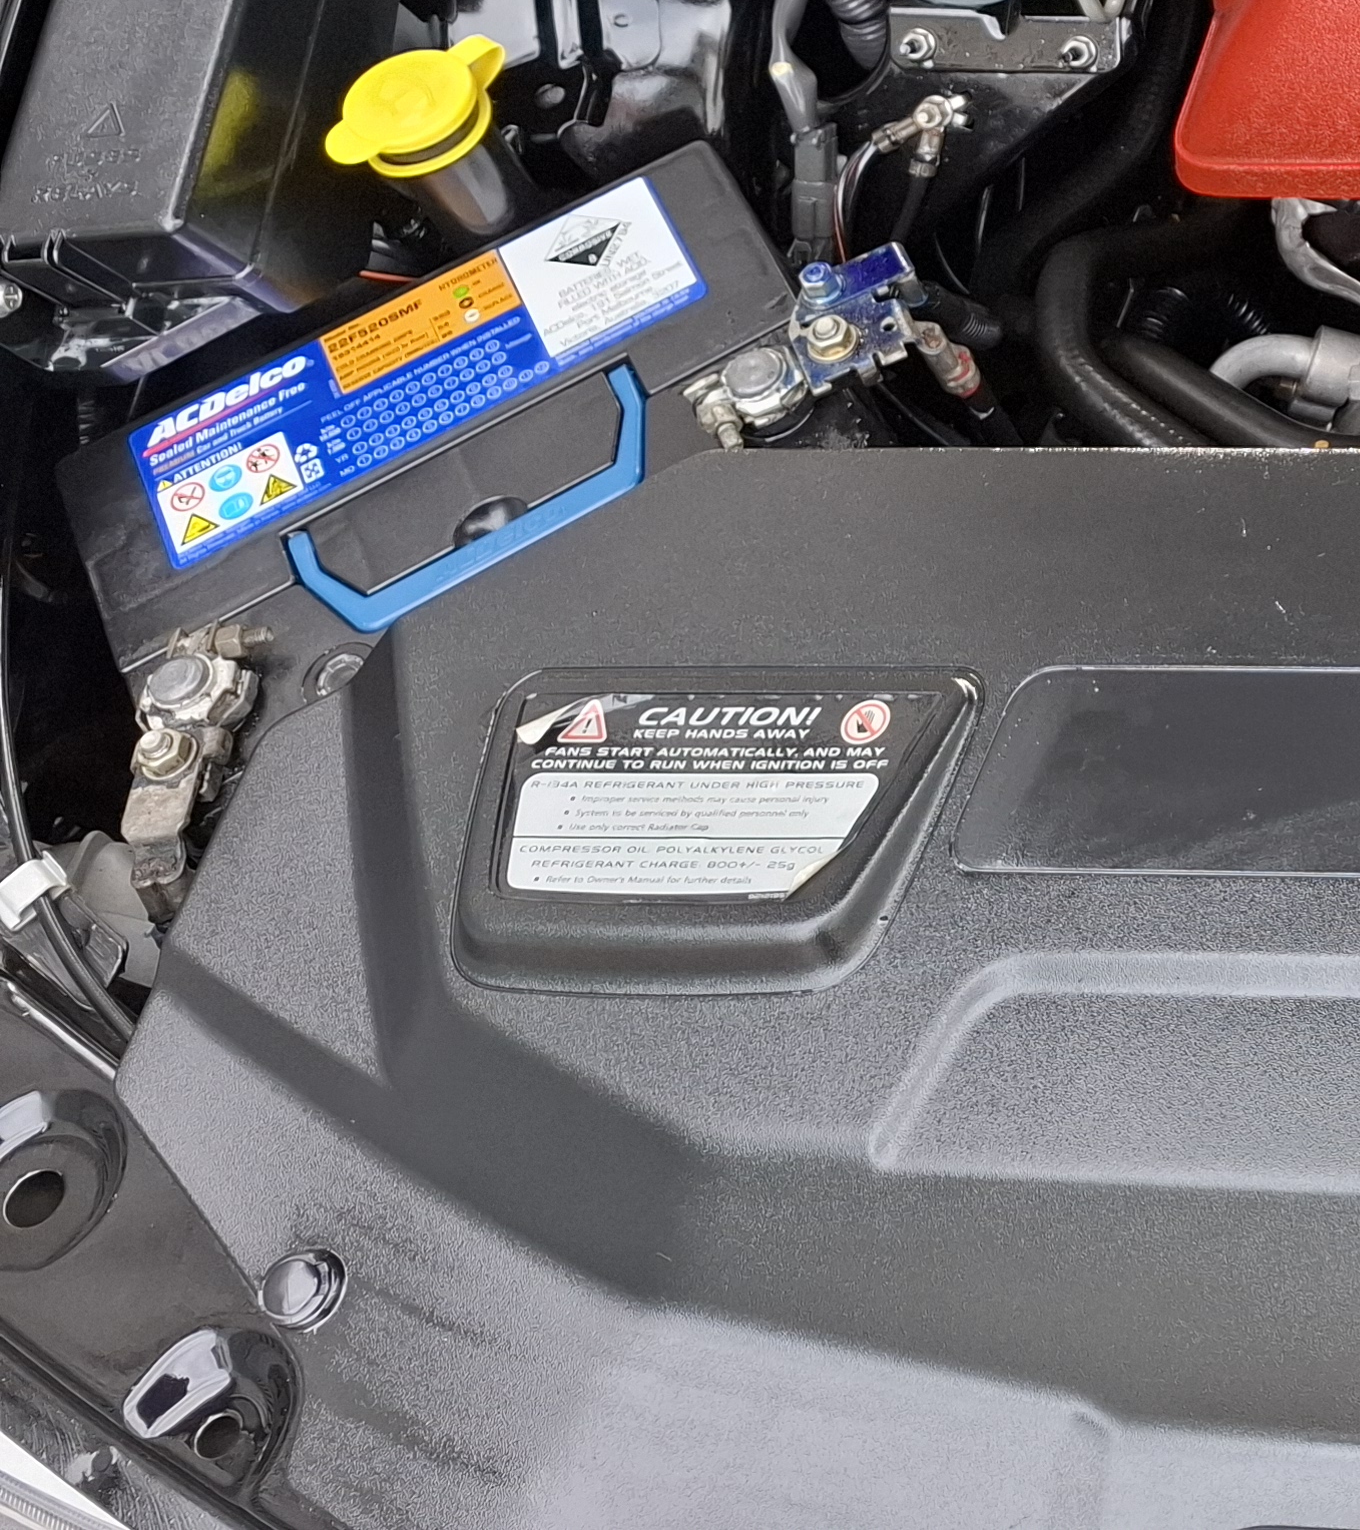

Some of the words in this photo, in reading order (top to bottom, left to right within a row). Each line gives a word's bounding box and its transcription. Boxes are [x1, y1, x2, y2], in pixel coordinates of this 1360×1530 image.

[557, 228, 613, 262] CORROSIVE
[599, 221, 632, 267] UN2794
[437, 256, 498, 292] HYDROMETER
[556, 285, 592, 309] FILLED
[592, 270, 622, 291] WITH
[600, 283, 654, 317] Melbourne
[325, 297, 424, 354] 22F520SMF
[318, 406, 344, 424] PEEL
[342, 397, 362, 412] OFF
[361, 370, 414, 402] APPLICABLE
[412, 351, 451, 376] NUMBER
[448, 337, 477, 356] WHEN
[475, 314, 522, 342] INSTALLED
[147, 354, 310, 448] ACDelco
[146, 435, 196, 467] Sealed
[192, 393, 278, 444] Maintenance
[274, 378, 308, 403] Free
[194, 440, 212, 454] Car
[210, 432, 229, 446] and
[228, 420, 253, 437] Truck
[251, 404, 285, 426] Battery
[170, 440, 244, 483] ATTENTION!
[638, 706, 823, 726] CAUTION!
[632, 728, 679, 739] KEEP
[685, 728, 748, 739] HANDS
[752, 728, 810, 739] AWAY
[530, 759, 616, 769] CONTINUE
[622, 759, 646, 769] TO
[649, 759, 689, 769] RUN
[692, 759, 746, 769] WHEN
[750, 759, 826, 770] IGNITION
[830, 759, 847, 770] IS
[852, 759, 889, 770] OFF
[543, 746, 592, 758] FANS
[596, 746, 653, 758] START
[656, 746, 798, 758] AUTOMATICALLY,
[802, 746, 841, 758] AND
[845, 746, 886, 758] MAY
[584, 780, 684, 789] REFRIGERANT
[689, 780, 740, 789] UNDER
[745, 780, 779, 789] HIGH
[784, 780, 864, 789] PRESSURE
[581, 795, 625, 804] Improper
[628, 795, 660, 804] service
[662, 795, 704, 804] methods
[729, 795, 756, 804] cause
[759, 795, 800, 804] personal
[568, 822, 586, 831] Use
[589, 822, 609, 831] only
[611, 822, 645, 831] correct
[647, 822, 688, 831] Radiator
[691, 822, 709, 831] Cap
[574, 809, 608, 818] System
[625, 809, 637, 818] be
[639, 809, 678, 818] serviced
[680, 809, 692, 818] by
[694, 809, 736, 818] qualified
[739, 809, 786, 818] personnel
[788, 809, 809, 818] only
[519, 845, 622, 854] COMPRESSOR
[656, 845, 764, 854] POLYALKYLENE
[770, 845, 823, 854] GLYCOL
[530, 860, 634, 869] REFRIGERANT
[766, 860, 795, 869] 25g
[545, 875, 570, 884] Refer
[574, 875, 583, 884] to
[586, 875, 624, 884] Owner's
[627, 875, 664, 884] Manual
[666, 875, 681, 884] for
[684, 875, 718, 884] further
[720, 875, 751, 884] details
